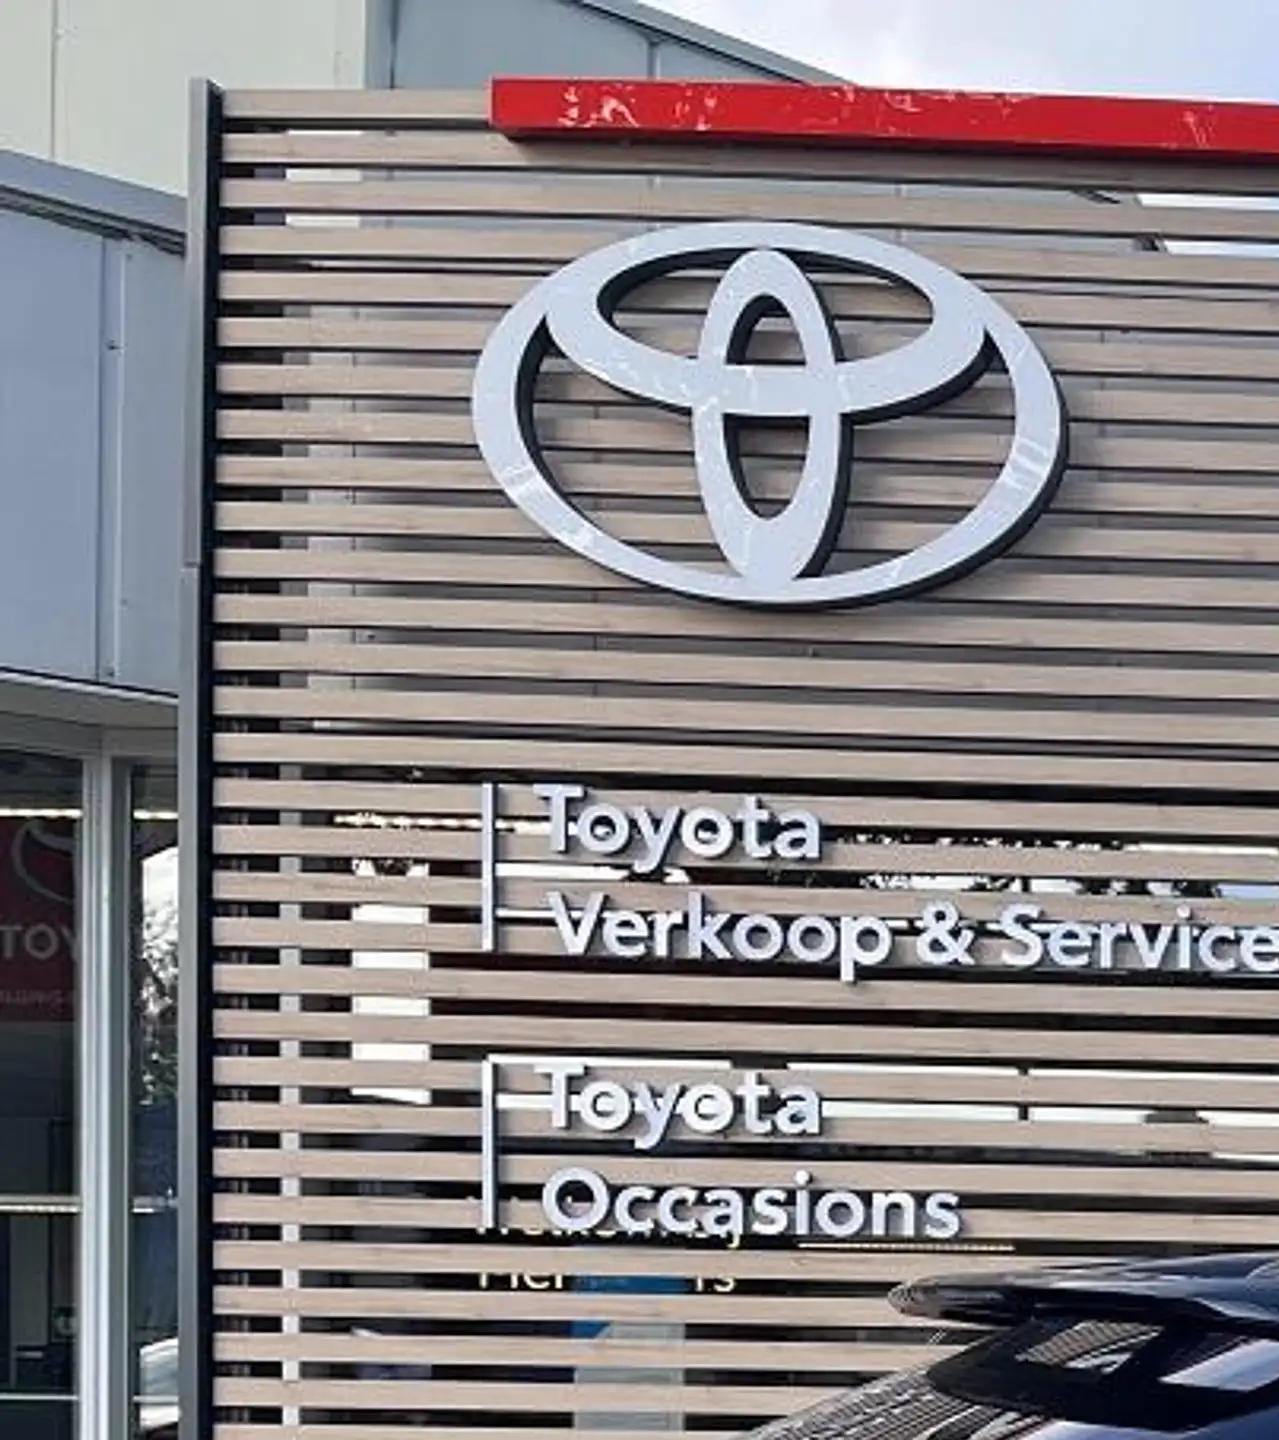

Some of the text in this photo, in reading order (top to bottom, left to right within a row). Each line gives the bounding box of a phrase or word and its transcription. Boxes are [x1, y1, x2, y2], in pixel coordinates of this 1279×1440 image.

[535, 784, 822, 872] Toyota
[546, 889, 895, 983] Verkoop
[914, 901, 976, 967] &
[535, 1064, 822, 1149] Toyota
[541, 1166, 964, 1241] Occasions
